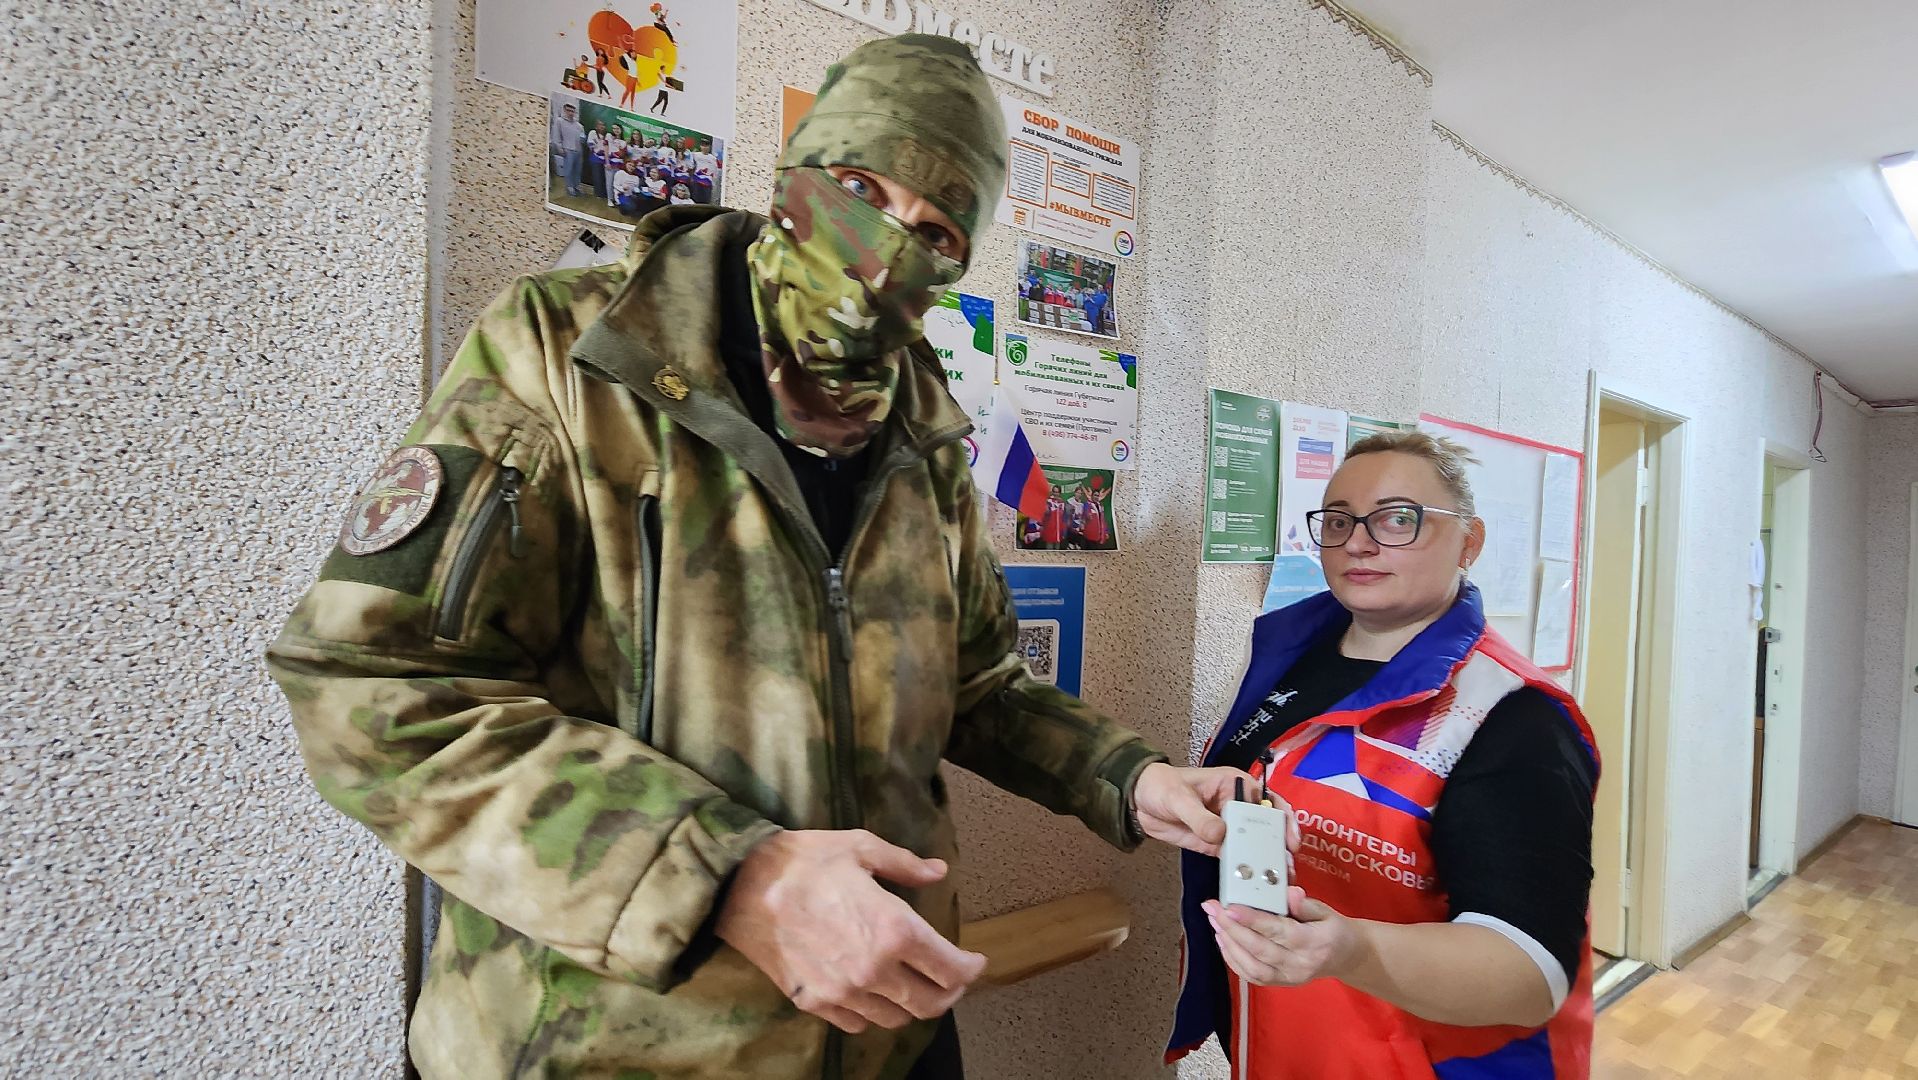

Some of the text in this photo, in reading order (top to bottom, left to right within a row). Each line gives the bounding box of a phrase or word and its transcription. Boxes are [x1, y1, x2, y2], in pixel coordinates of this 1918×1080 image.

[1023, 109, 1059, 131] СБОР
[1065, 125, 1121, 156] ПОМОЩИ
[1049, 201, 1112, 228] #МЫВМЕСТЕ
[1034, 362, 1108, 380] Горячих линий для
[1051, 354, 1091, 367] Телефоны
[1015, 369, 1084, 386] мобилизованных
[1102, 382, 1125, 391] семей
[1294, 809, 1417, 867] ОЛОНТЕРЫ
[1302, 834, 1434, 890] ДМОСКОВЬ
